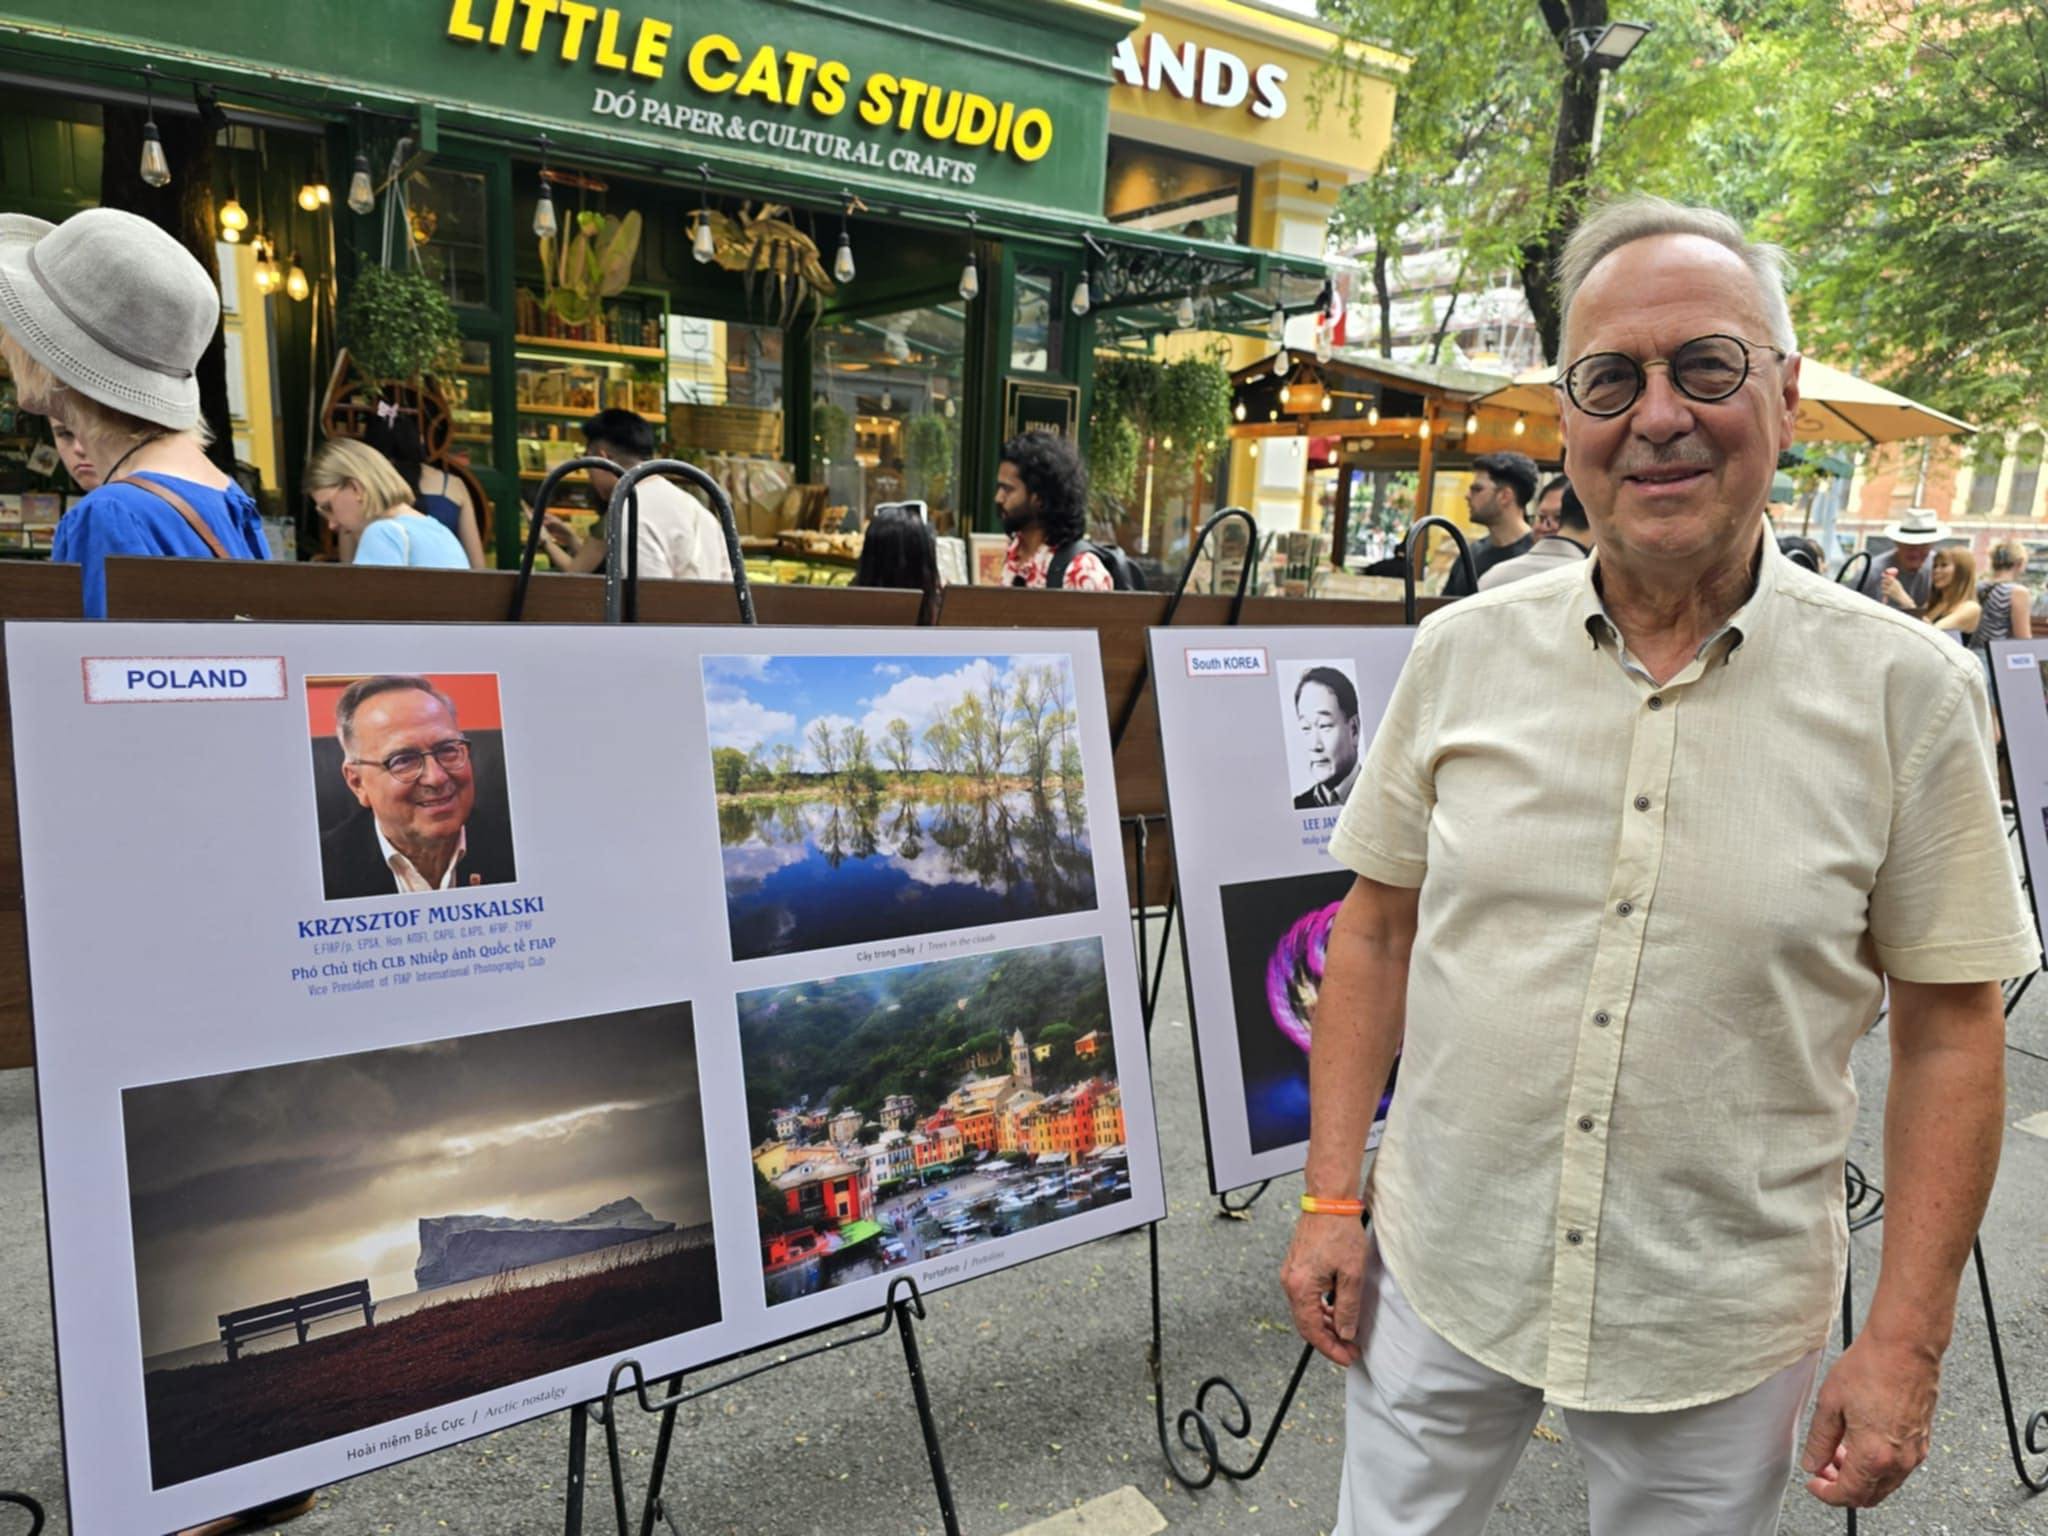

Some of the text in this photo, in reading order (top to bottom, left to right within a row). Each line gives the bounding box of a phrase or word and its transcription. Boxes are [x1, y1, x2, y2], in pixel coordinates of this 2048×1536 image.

[448, 0, 1053, 162] LITTLE CATS STUDIO
[592, 88, 636, 118] DÓ
[888, 147, 977, 185] CRAFTS
[127, 669, 247, 689] POLAND
[1192, 656, 1261, 670] South KOREA
[1303, 817, 1320, 831] LEE
[297, 896, 545, 938] KRZYSZTOF MUSKALSKI
[352, 958, 378, 975] tịch
[381, 955, 406, 969] CLB
[480, 940, 511, 958] Quốc
[529, 936, 556, 951] FIAP
[874, 948, 896, 960] trong
[308, 984, 329, 996] Vice
[332, 978, 375, 993] President
[380, 975, 389, 987] of
[393, 971, 412, 984] FIAP
[346, 1442, 377, 1461] Hoài
[414, 1421, 438, 1441] Bắc
[441, 1416, 466, 1433] Cực
[484, 1401, 518, 1420] Arctic
[521, 1385, 568, 1408] nostalgy
